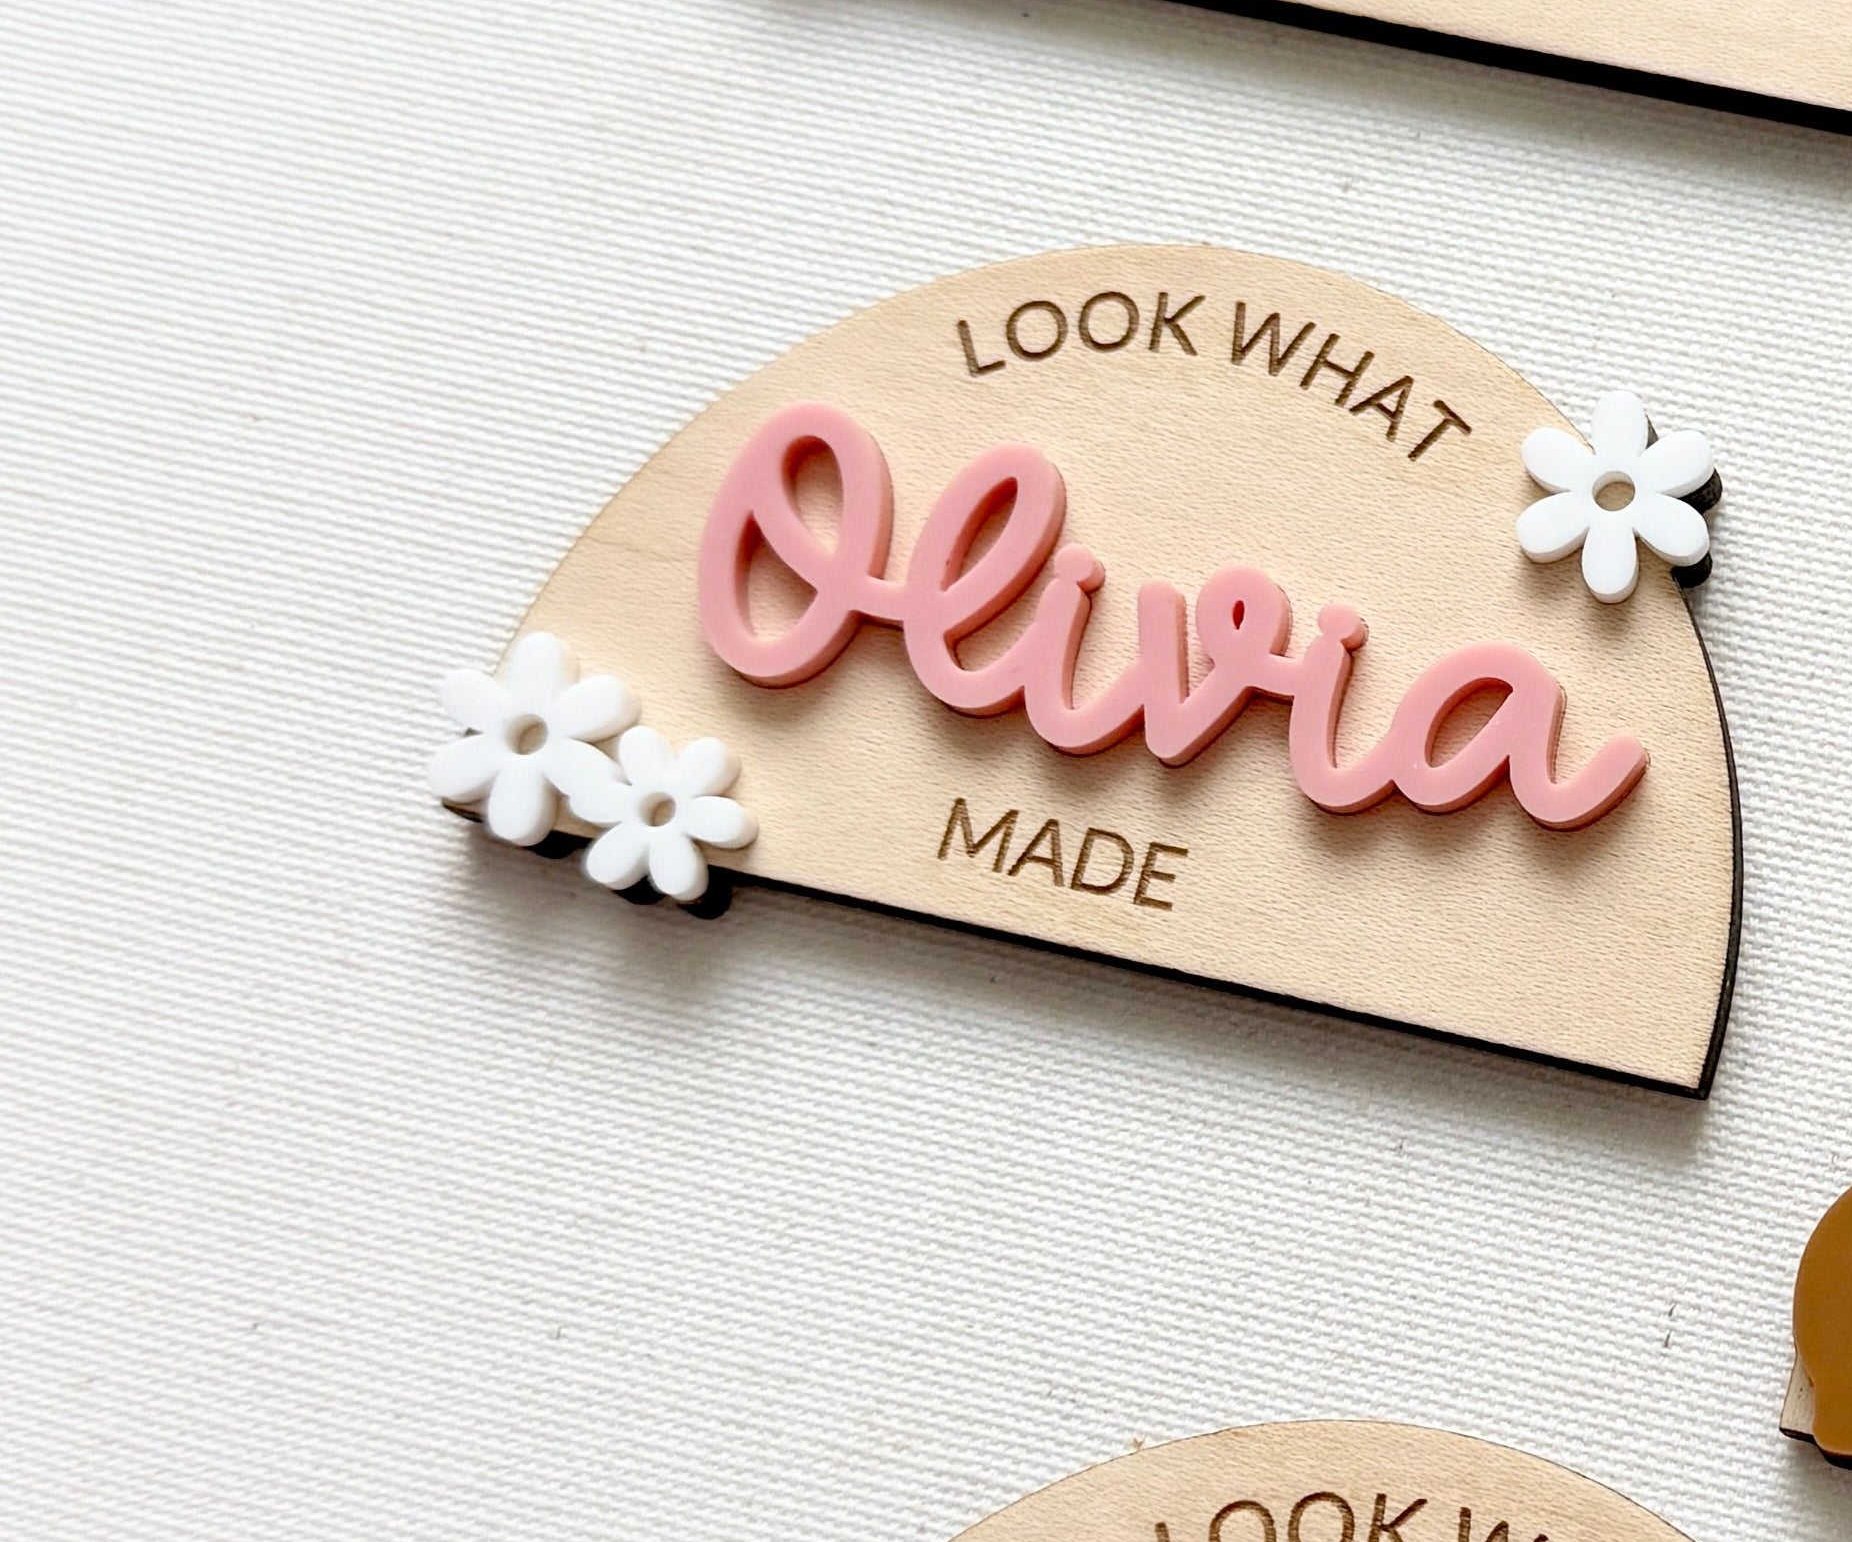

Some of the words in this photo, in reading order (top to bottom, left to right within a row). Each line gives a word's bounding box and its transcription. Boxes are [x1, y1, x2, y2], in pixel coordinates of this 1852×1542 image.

[957, 290, 1206, 377] LOOK
[1229, 301, 1472, 463] WHAT
[697, 404, 1649, 832] Olivia
[938, 797, 1189, 910] MADE
